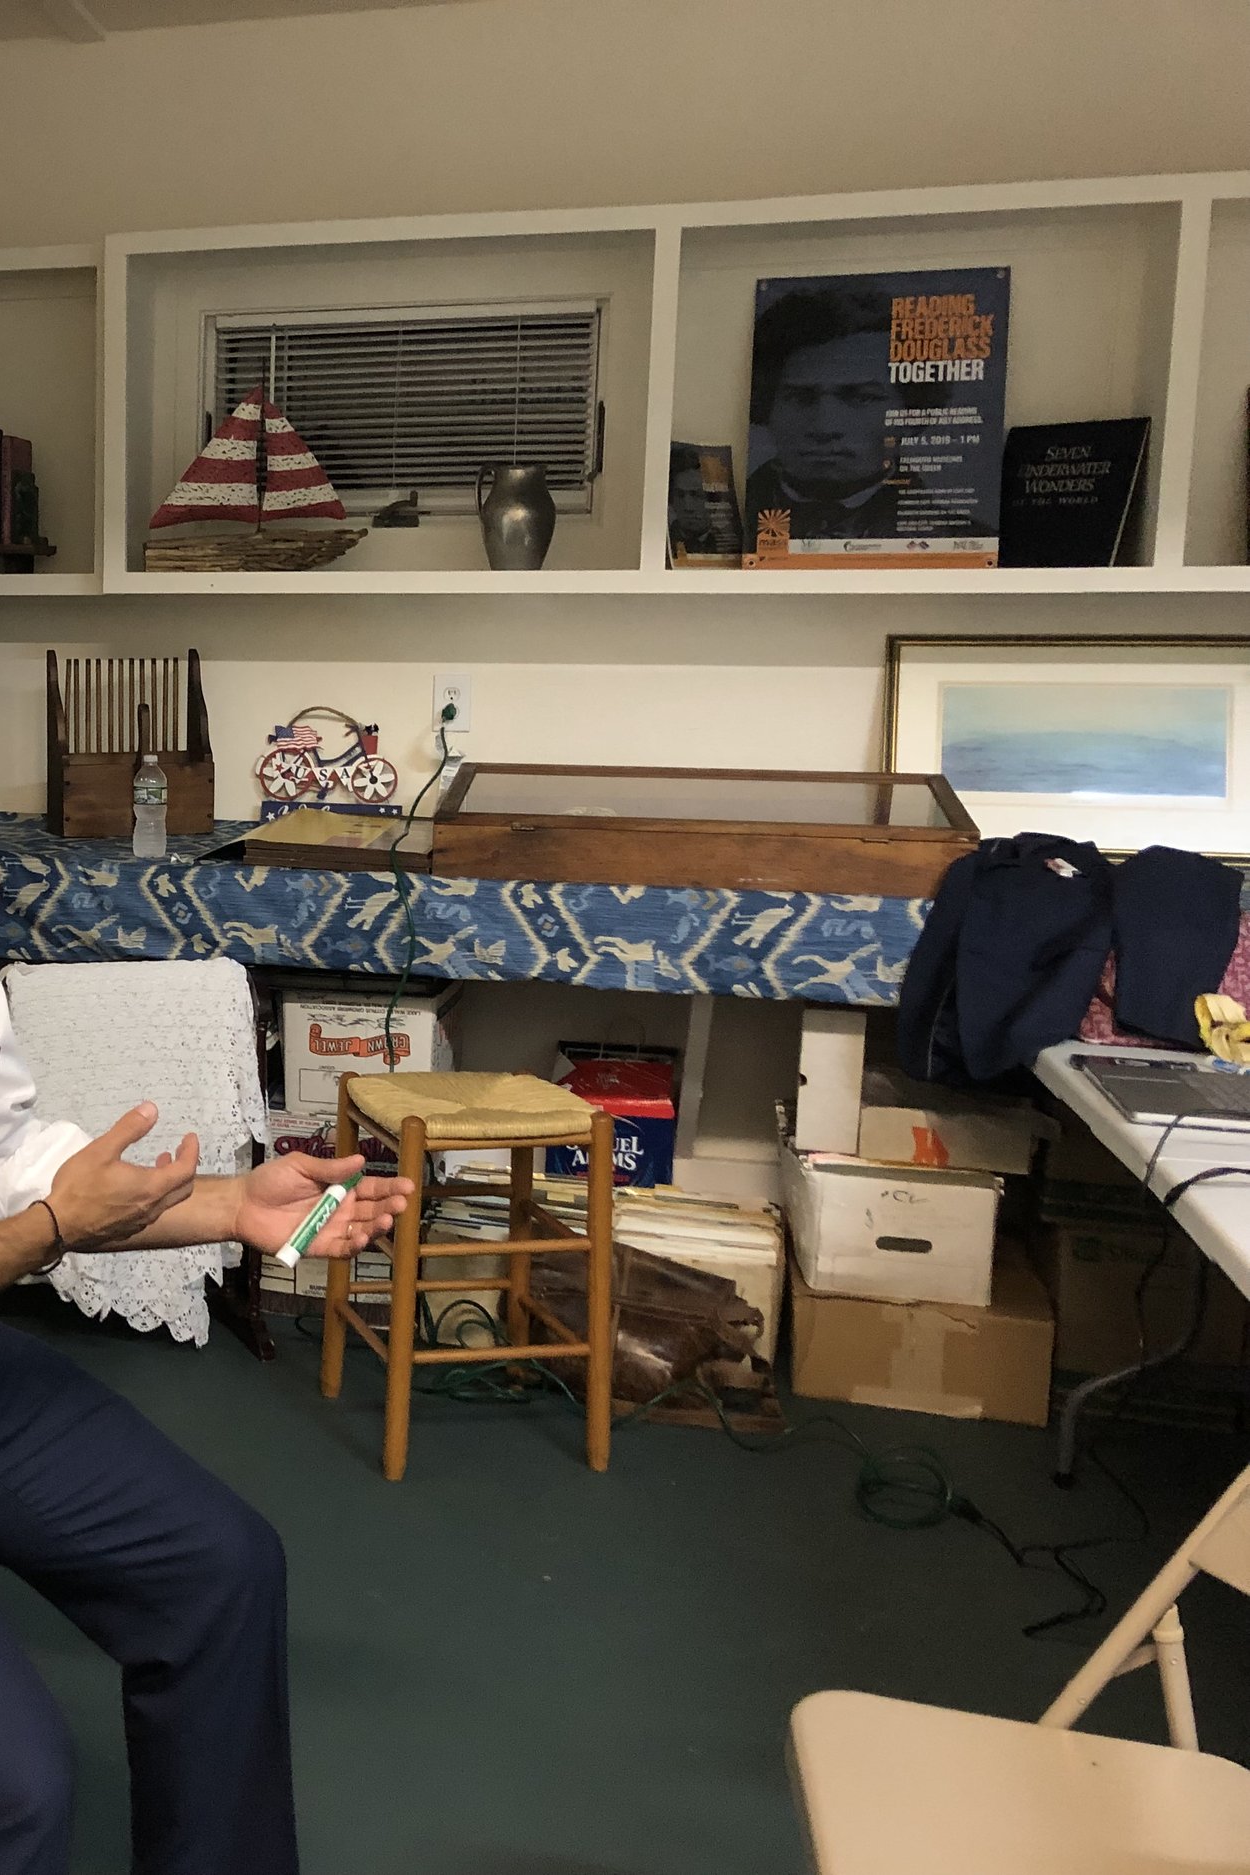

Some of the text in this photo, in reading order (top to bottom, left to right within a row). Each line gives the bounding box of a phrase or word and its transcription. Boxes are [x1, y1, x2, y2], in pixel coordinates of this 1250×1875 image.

[891, 294, 975, 318] READING
[890, 314, 995, 340] FREDERICK
[889, 337, 992, 362] DOUGLASS
[888, 359, 984, 383] TOGETHER
[901, 436, 918, 446] JULY
[966, 434, 980, 445] PM
[1045, 446, 1092, 460] SEVEN
[1017, 461, 1111, 478] UNDERWATER
[1025, 478, 1095, 493] WONDERS
[1058, 496, 1099, 505] WORLD
[300, 1003, 336, 1011] ASSOCIATION
[315, 1039, 352, 1052] JEWEL
